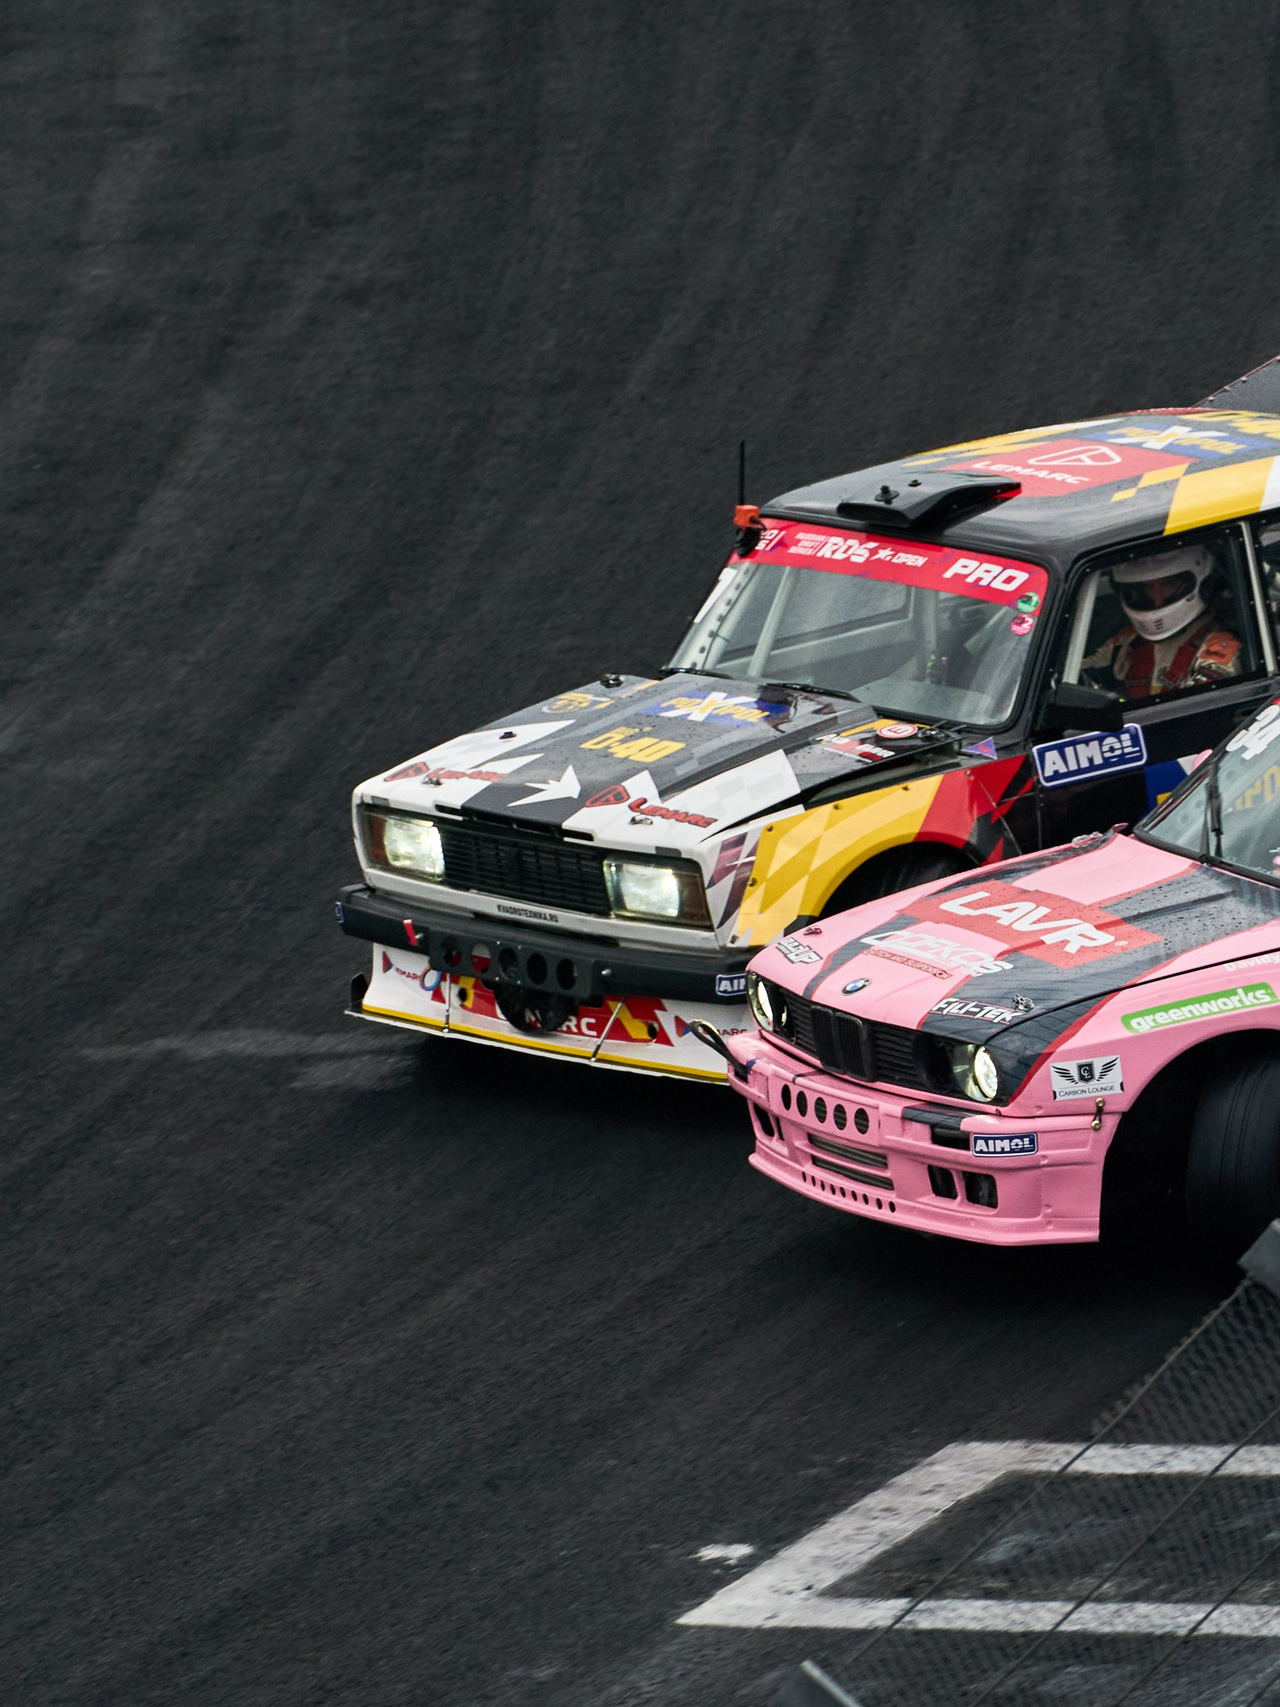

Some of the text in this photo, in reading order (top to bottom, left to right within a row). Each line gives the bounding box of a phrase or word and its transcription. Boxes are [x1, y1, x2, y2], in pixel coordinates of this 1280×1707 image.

[972, 461, 1090, 484] LEMARC
[816, 536, 879, 564] RDS
[891, 552, 928, 567] OPEN
[942, 558, 1030, 591] PRO
[1043, 733, 1141, 777] AIMOL
[628, 797, 718, 828] LEMARC
[938, 891, 1115, 954] LAVR
[1130, 988, 1272, 1033] greenworks
[1058, 1084, 1115, 1097] CARBON LOUNGE
[975, 1138, 1034, 1152] AIMOL
